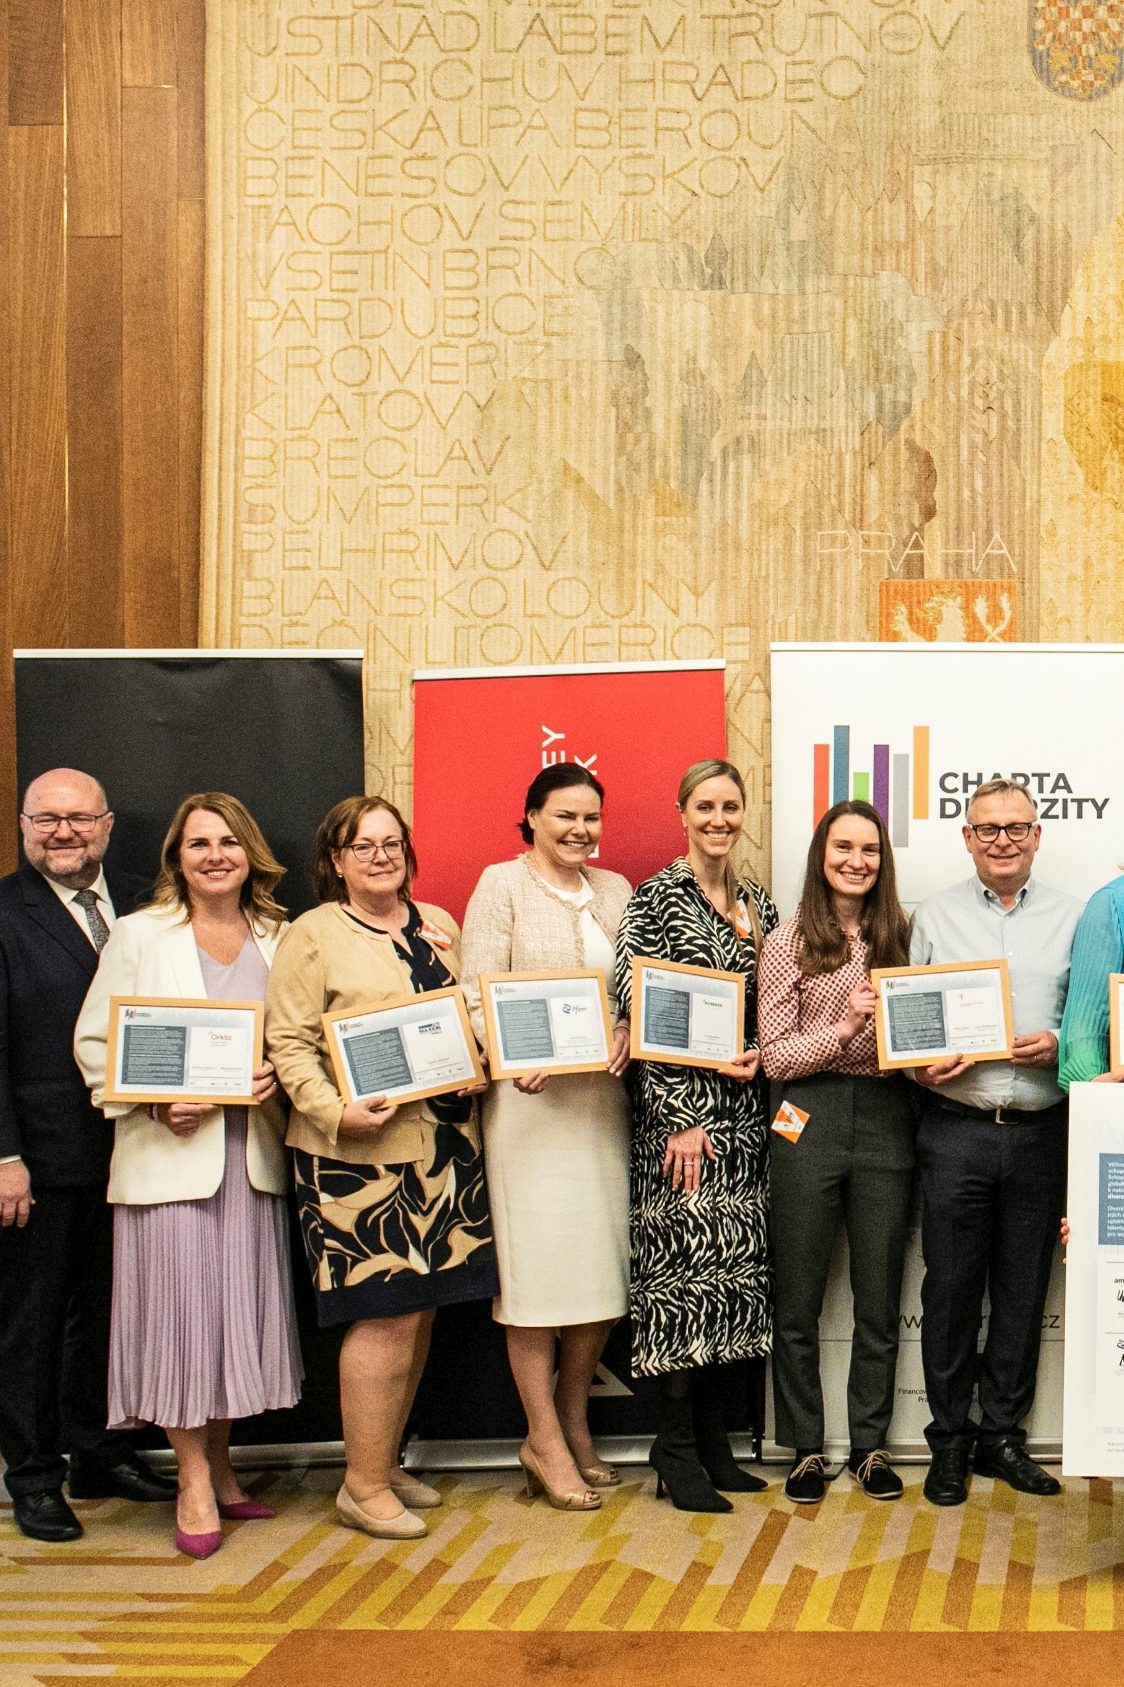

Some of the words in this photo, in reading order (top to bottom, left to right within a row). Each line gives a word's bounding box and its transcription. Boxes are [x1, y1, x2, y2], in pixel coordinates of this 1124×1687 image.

[366, 10, 481, 56] NAD
[493, 12, 687, 56] LABEM
[700, 10, 966, 56] TRUTNOV
[618, 56, 867, 103] HRADEC
[574, 107, 828, 151] BEROUN
[243, 202, 486, 246] TACHOV
[498, 199, 693, 243] SEMILY
[443, 247, 617, 290] BRNO
[246, 292, 574, 340] PARDUBICE
[244, 389, 497, 432] KLATOVY
[816, 530, 1018, 572] PRAHA
[239, 576, 509, 619] BLANSKO
[523, 575, 717, 619] LOUNY
